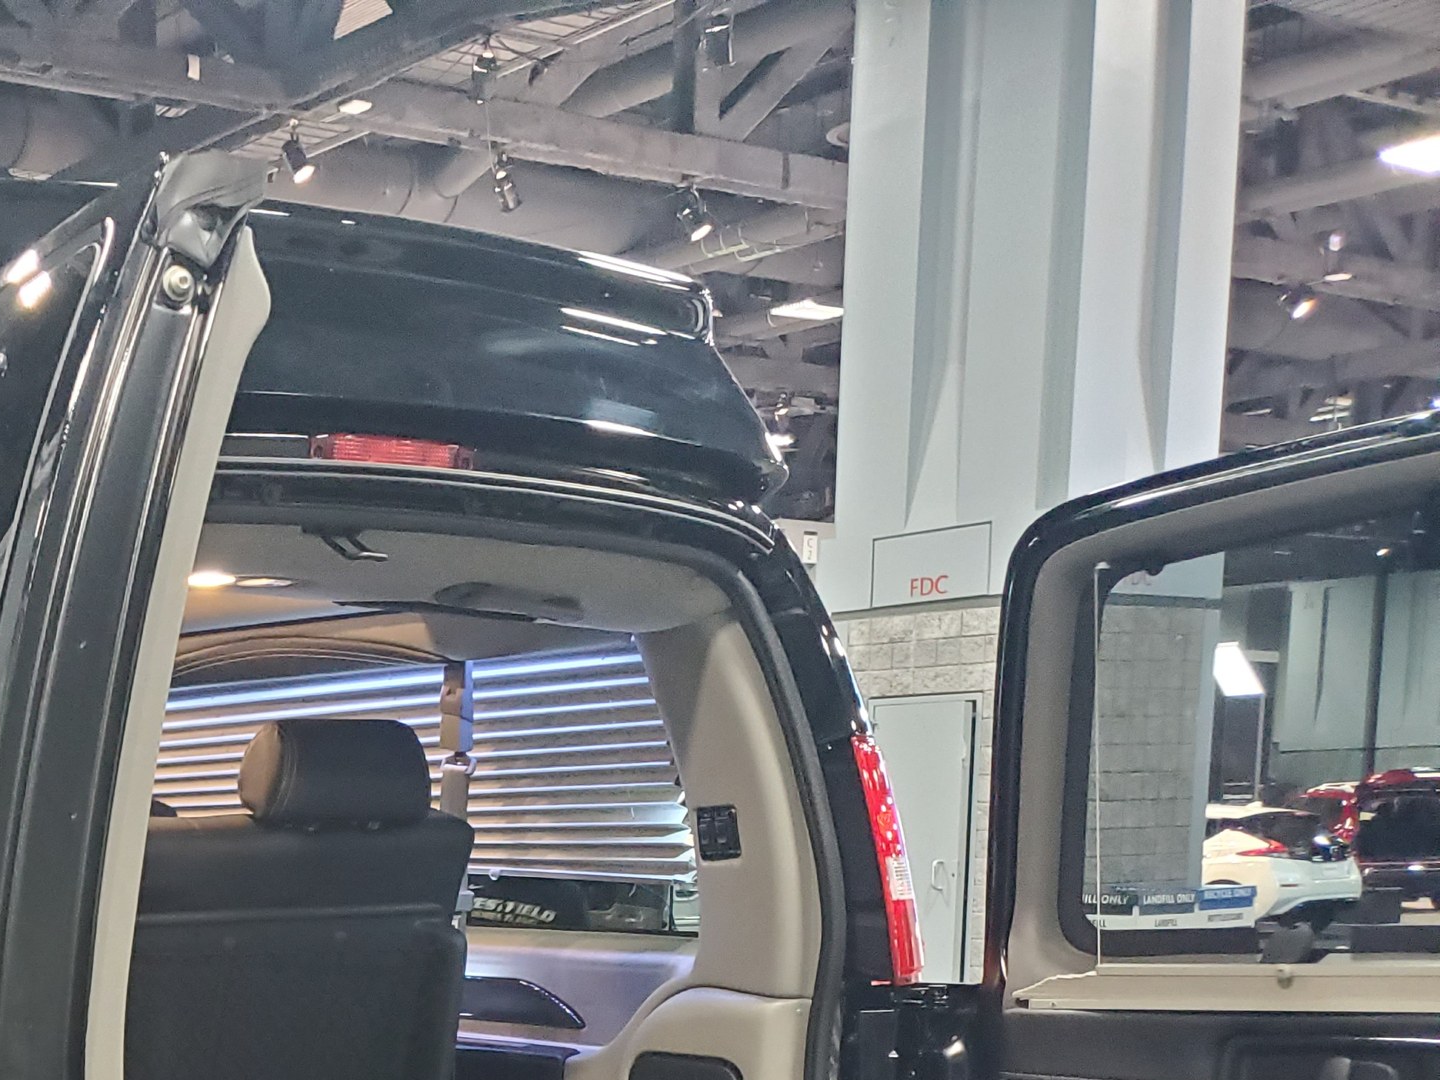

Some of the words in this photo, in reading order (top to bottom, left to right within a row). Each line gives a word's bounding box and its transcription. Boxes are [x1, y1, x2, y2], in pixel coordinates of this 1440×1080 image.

[910, 575, 949, 597] FDC
[1101, 894, 1129, 904] ONLY
[1143, 894, 1175, 904] LANDFILL
[1176, 893, 1195, 903] ONLY
